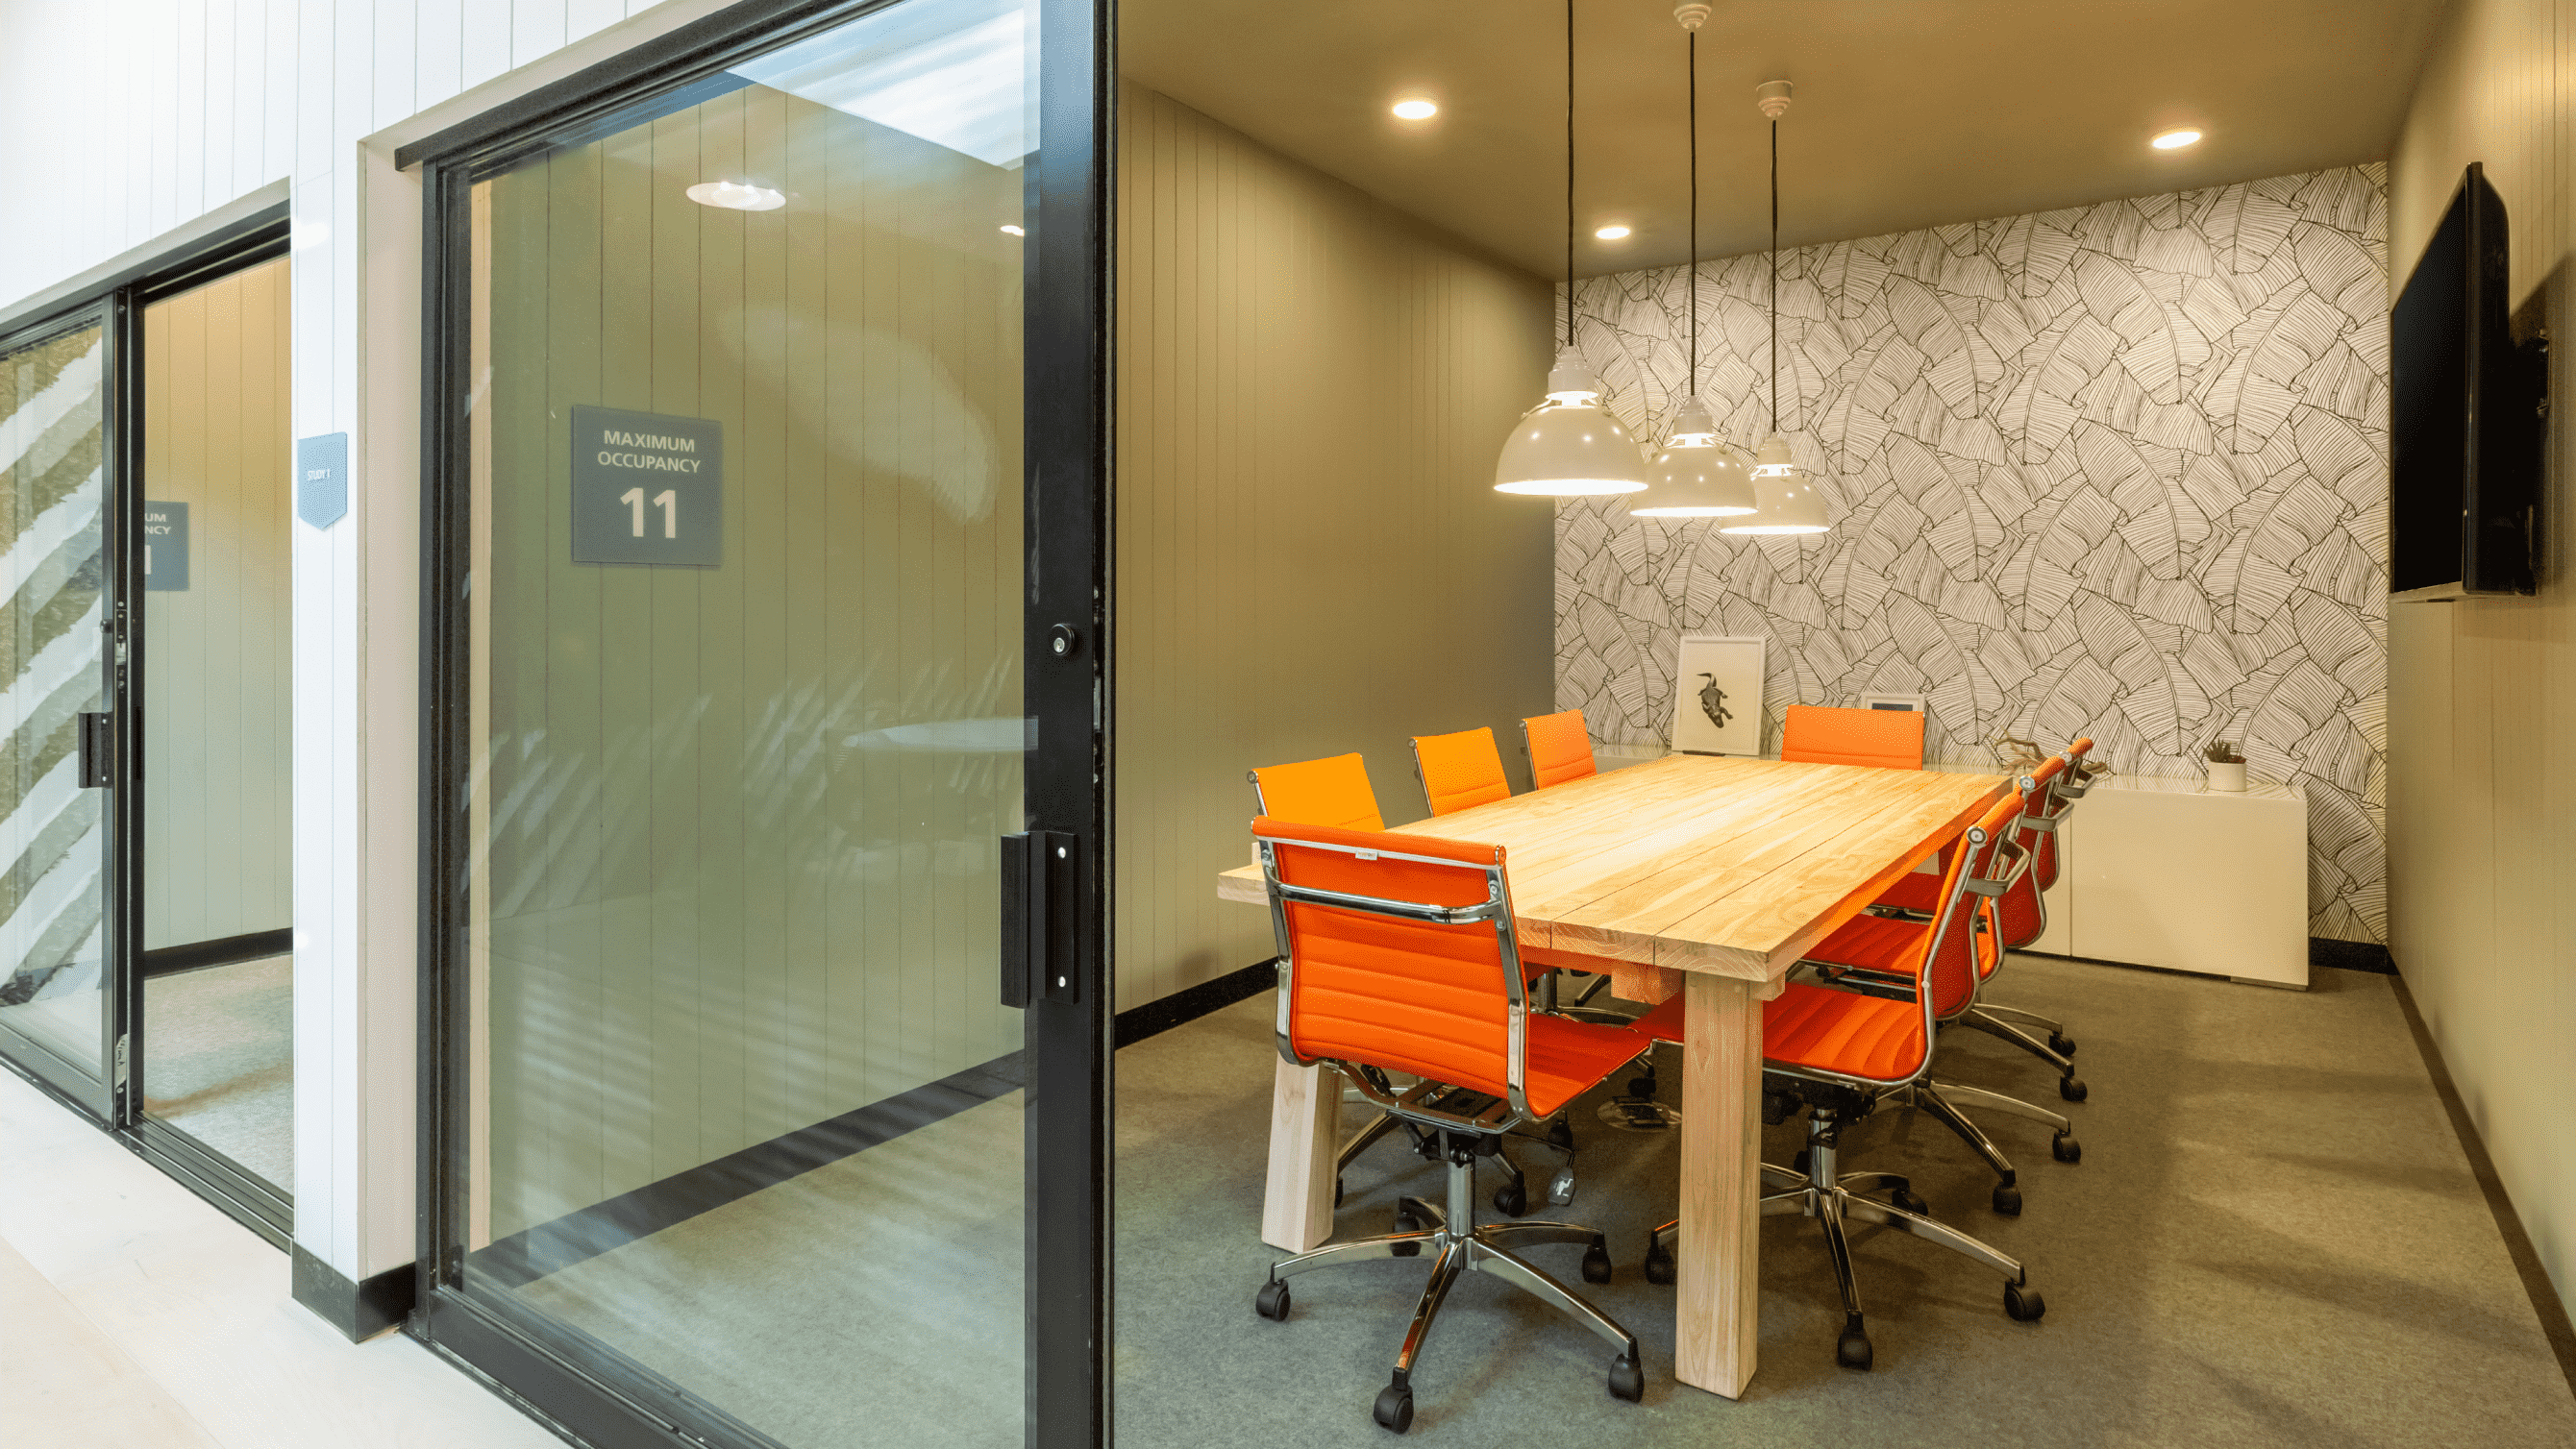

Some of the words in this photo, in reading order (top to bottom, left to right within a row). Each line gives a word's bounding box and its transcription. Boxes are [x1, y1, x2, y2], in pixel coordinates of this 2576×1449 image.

[604, 430, 695, 453] MAXIMUM
[597, 451, 701, 473] OCCUPANCY
[620, 487, 676, 538] 11
